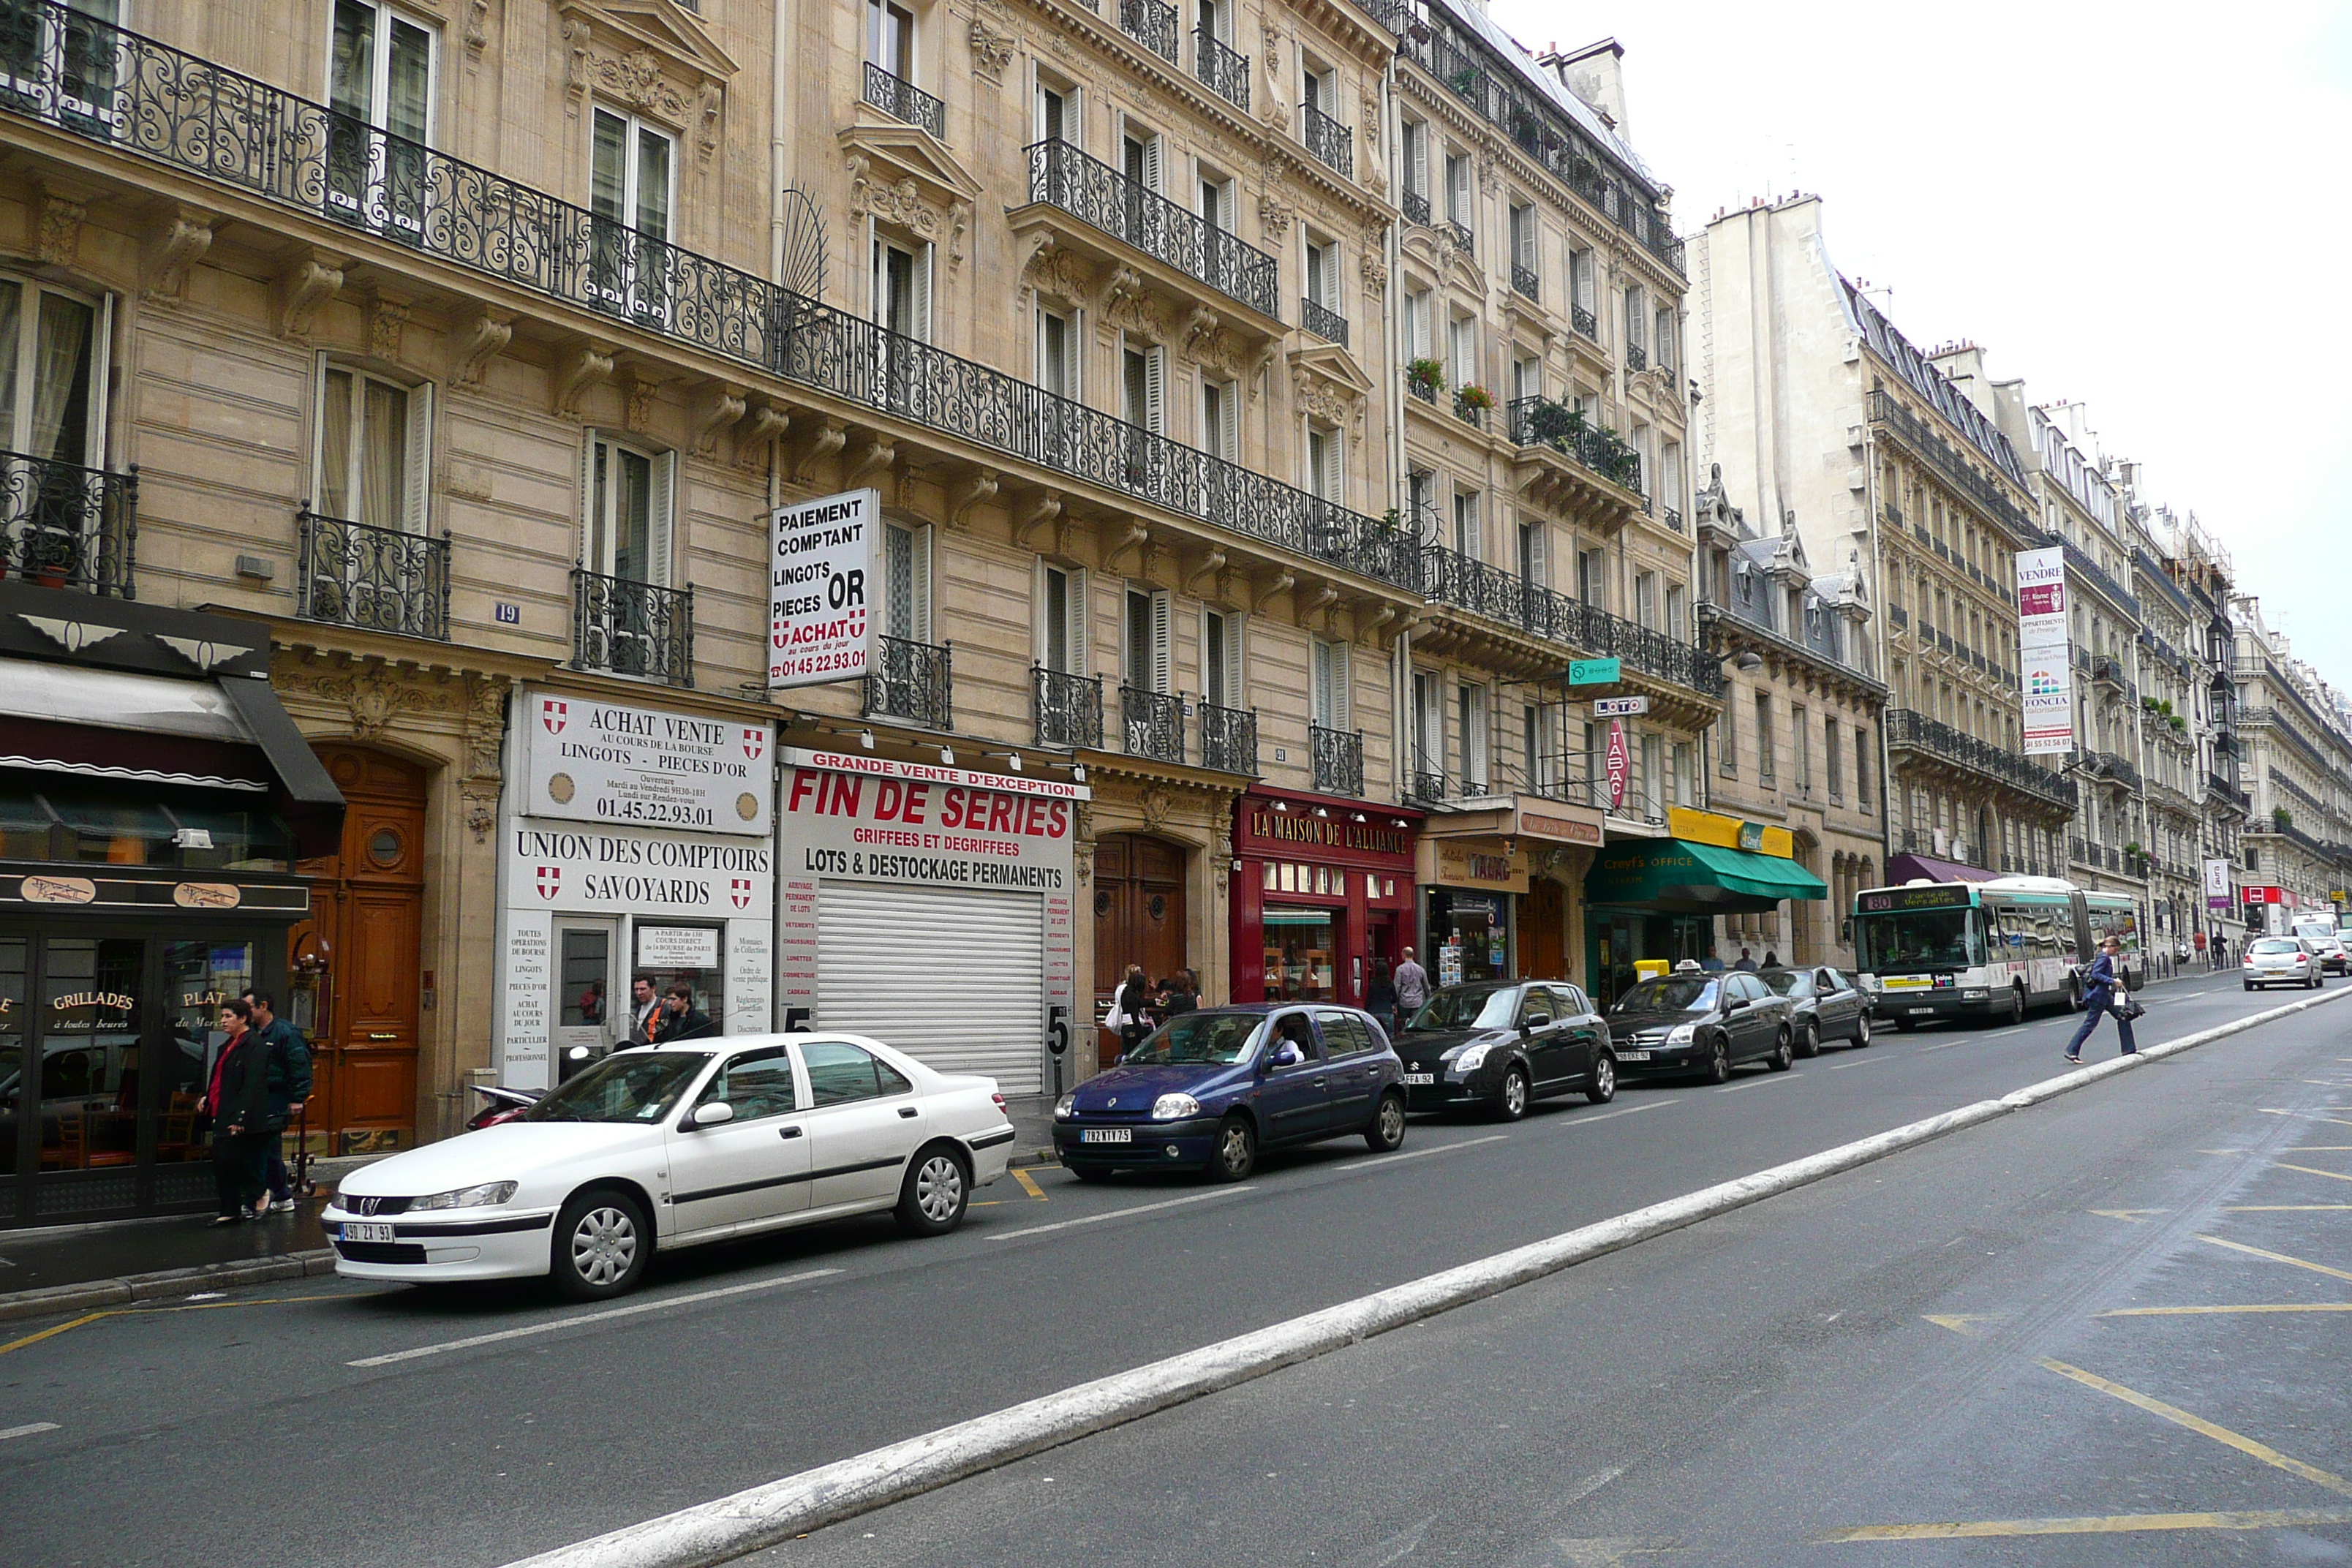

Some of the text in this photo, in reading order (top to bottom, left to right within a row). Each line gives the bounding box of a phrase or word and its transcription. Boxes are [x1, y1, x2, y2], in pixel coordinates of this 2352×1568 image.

[779, 500, 862, 532] PAIEMENT
[777, 524, 863, 557] COMPTANT
[2036, 558, 2044, 568] A
[774, 561, 830, 587] LINGOTS
[2019, 567, 2062, 581] VENDRE
[828, 568, 864, 610] OR
[500, 604, 515, 621] 19
[773, 595, 821, 618] PIECES
[2021, 619, 2065, 628] APPARTEMENTS
[791, 619, 848, 645] ACHAT
[800, 643, 819, 653] cours
[823, 641, 832, 651] du
[834, 639, 849, 651] jour
[1597, 698, 1640, 714] LOTO
[2025, 697, 2068, 707] FONCIA
[2025, 706, 2070, 715] Valorisation
[589, 708, 725, 745] ACHAT VENTE
[600, 734, 715, 756] AU COURS DE LA BOURSE
[561, 742, 747, 777] LINGOTS PIECES D'OR
[1607, 732, 1624, 795] TABAC
[640, 774, 675, 785] Ouverture
[813, 753, 1075, 796] GRANDE VENTE D'EXCEPTION
[607, 780, 627, 789] Mardi
[640, 783, 670, 794] Vendredi
[671, 787, 706, 796] 9H30-18H
[618, 790, 638, 799] Lundi
[652, 794, 695, 804] Rendez-vous
[788, 768, 863, 818] FIN
[874, 778, 930, 825] DE
[941, 787, 1068, 839] SERIES
[597, 797, 715, 826] 01.45.22.93.01
[853, 827, 1019, 856] GRIFFEES ET DEGRIFFEES
[1253, 813, 1406, 854] LA MAISON DE L'ALLIANCE
[516, 831, 769, 872] UNION DES COMPTOIRS
[805, 848, 1062, 889] LOTS & DESTOCKAGE PERMANENTS
[1651, 857, 1692, 867] OFFICE
[585, 875, 709, 905] SAVOYARDS
[788, 882, 813, 890] ARRIVAGE
[785, 893, 815, 902] PERMANENT
[1872, 897, 1889, 908] 80
[741, 946, 768, 954] Collections
[747, 976, 768, 984] publique
[53, 992, 135, 1010] GRILLADES
[183, 991, 226, 1006] PLAT
[64, 1019, 91, 1029] toutes
[96, 1019, 128, 1029] heures
[176, 1017, 189, 1028] du
[506, 1054, 547, 1062] PROFESSIONNEL
[364, 1226, 373, 1240] ZX
[380, 1226, 390, 1240] 93
